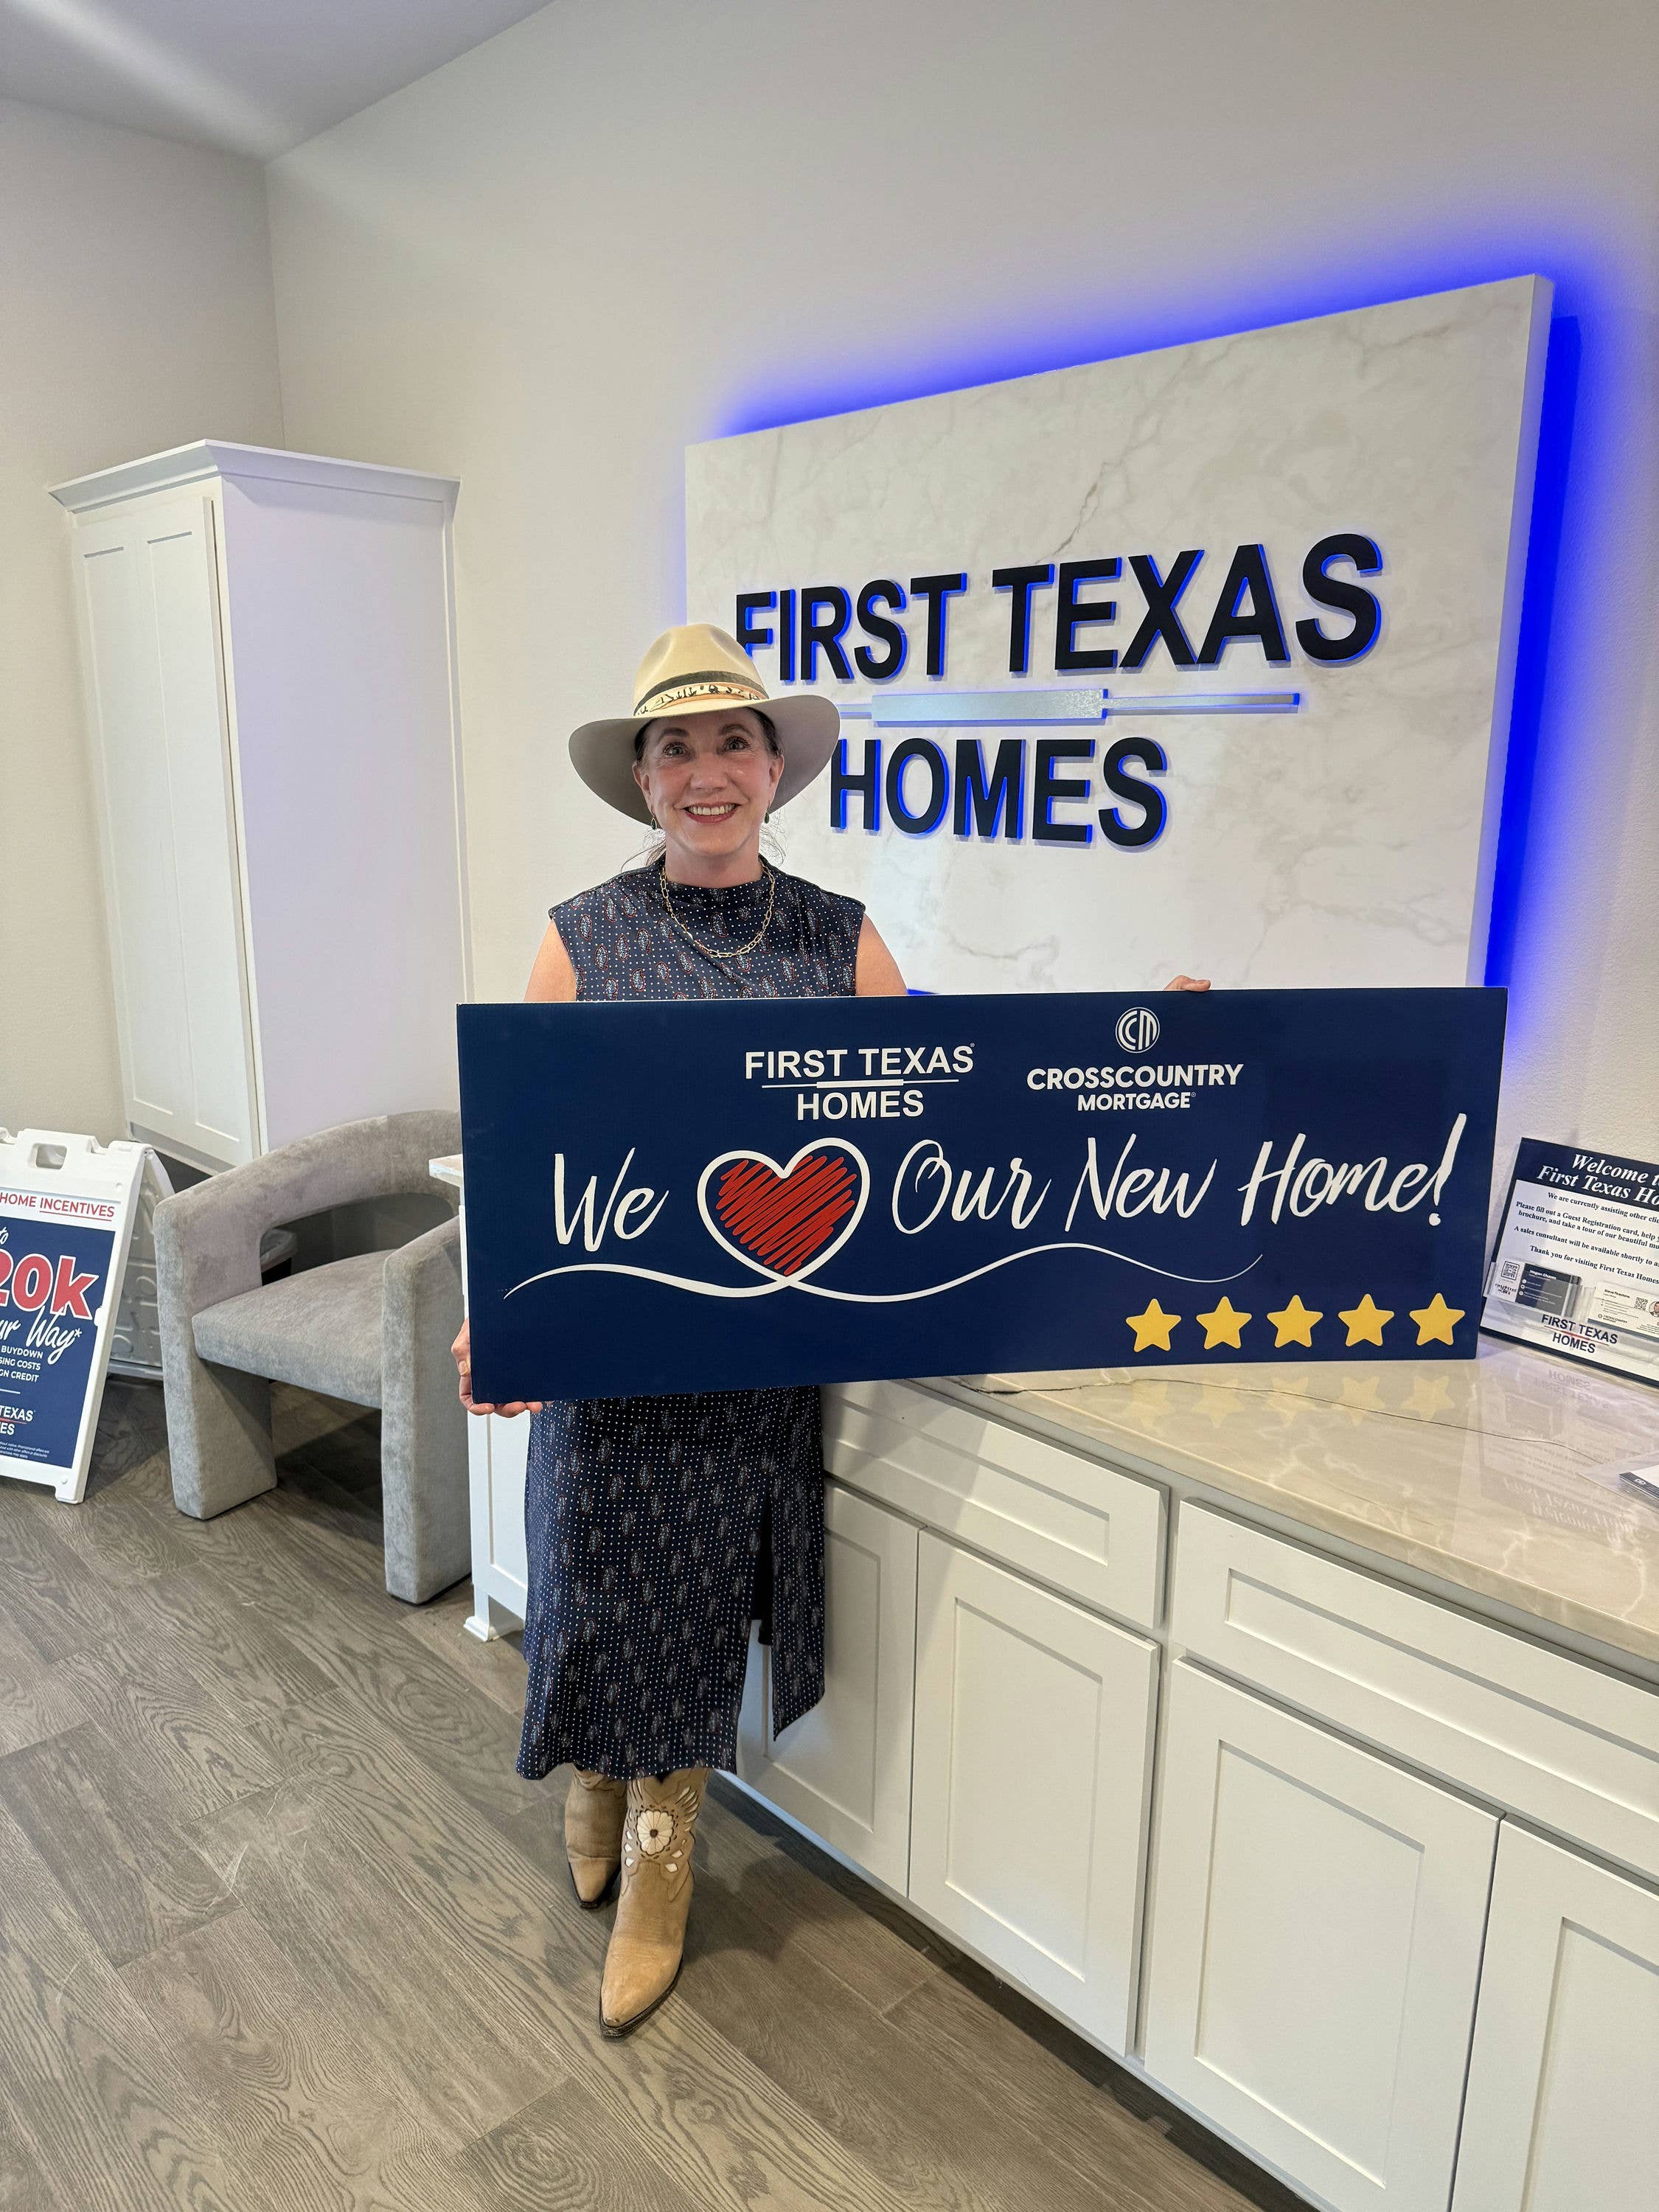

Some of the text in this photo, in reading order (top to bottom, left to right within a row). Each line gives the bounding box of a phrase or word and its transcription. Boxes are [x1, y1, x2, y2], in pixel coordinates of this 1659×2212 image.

[737, 533, 1383, 683] FIRST TEXAS
[830, 737, 1168, 847] HOMES
[745, 1048, 848, 1079] FIRST
[1026, 1063, 1244, 1091] CROSSCOUNTRY
[797, 1089, 924, 1121] HOMES
[554, 1112, 1467, 1252] We Our New Home!
[1536, 1165, 1579, 1187] First
[1581, 1175, 1632, 1199] Texas
[1572, 1153, 1649, 1183] Welcome
[0, 1192, 116, 1218] HOME INCENTIVES
[1516, 1200, 1535, 1211] Please
[1536, 1206, 1545, 1214] fill
[1562, 1211, 1582, 1222] Guest
[1582, 1216, 1621, 1231] Registration
[1641, 1231, 1656, 1241] help
[1548, 1192, 1558, 1200] We
[1570, 1199, 1600, 1211] currently
[1601, 1206, 1629, 1217] assisting
[1629, 1211, 1648, 1221] other
[1518, 1209, 1548, 1223] brochure,
[1562, 1221, 1576, 1229] take
[1582, 1225, 1597, 1234] tour
[1618, 1234, 1648, 1247] beautiful
[1520, 1227, 1534, 1236] sales
[1535, 1231, 1568, 1244] consultant
[1568, 1239, 1581, 1247] will
[1590, 1245, 1620, 1257] available
[1620, 1252, 1645, 1265] shortly
[1529, 1245, 1550, 1256] Thank
[1574, 1257, 1599, 1270] visiting
[1599, 1262, 1615, 1273] First
[1616, 1267, 1635, 1279] Texas
[1541, 1314, 1576, 1332] FIRST
[1579, 1324, 1618, 1344] TEXAS
[1552, 1332, 1596, 1354] HOMES
[1, 1344, 44, 1360] BUYDOWN
[16, 1360, 41, 1371] COSTS
[10, 1371, 40, 1382] CREDIT
